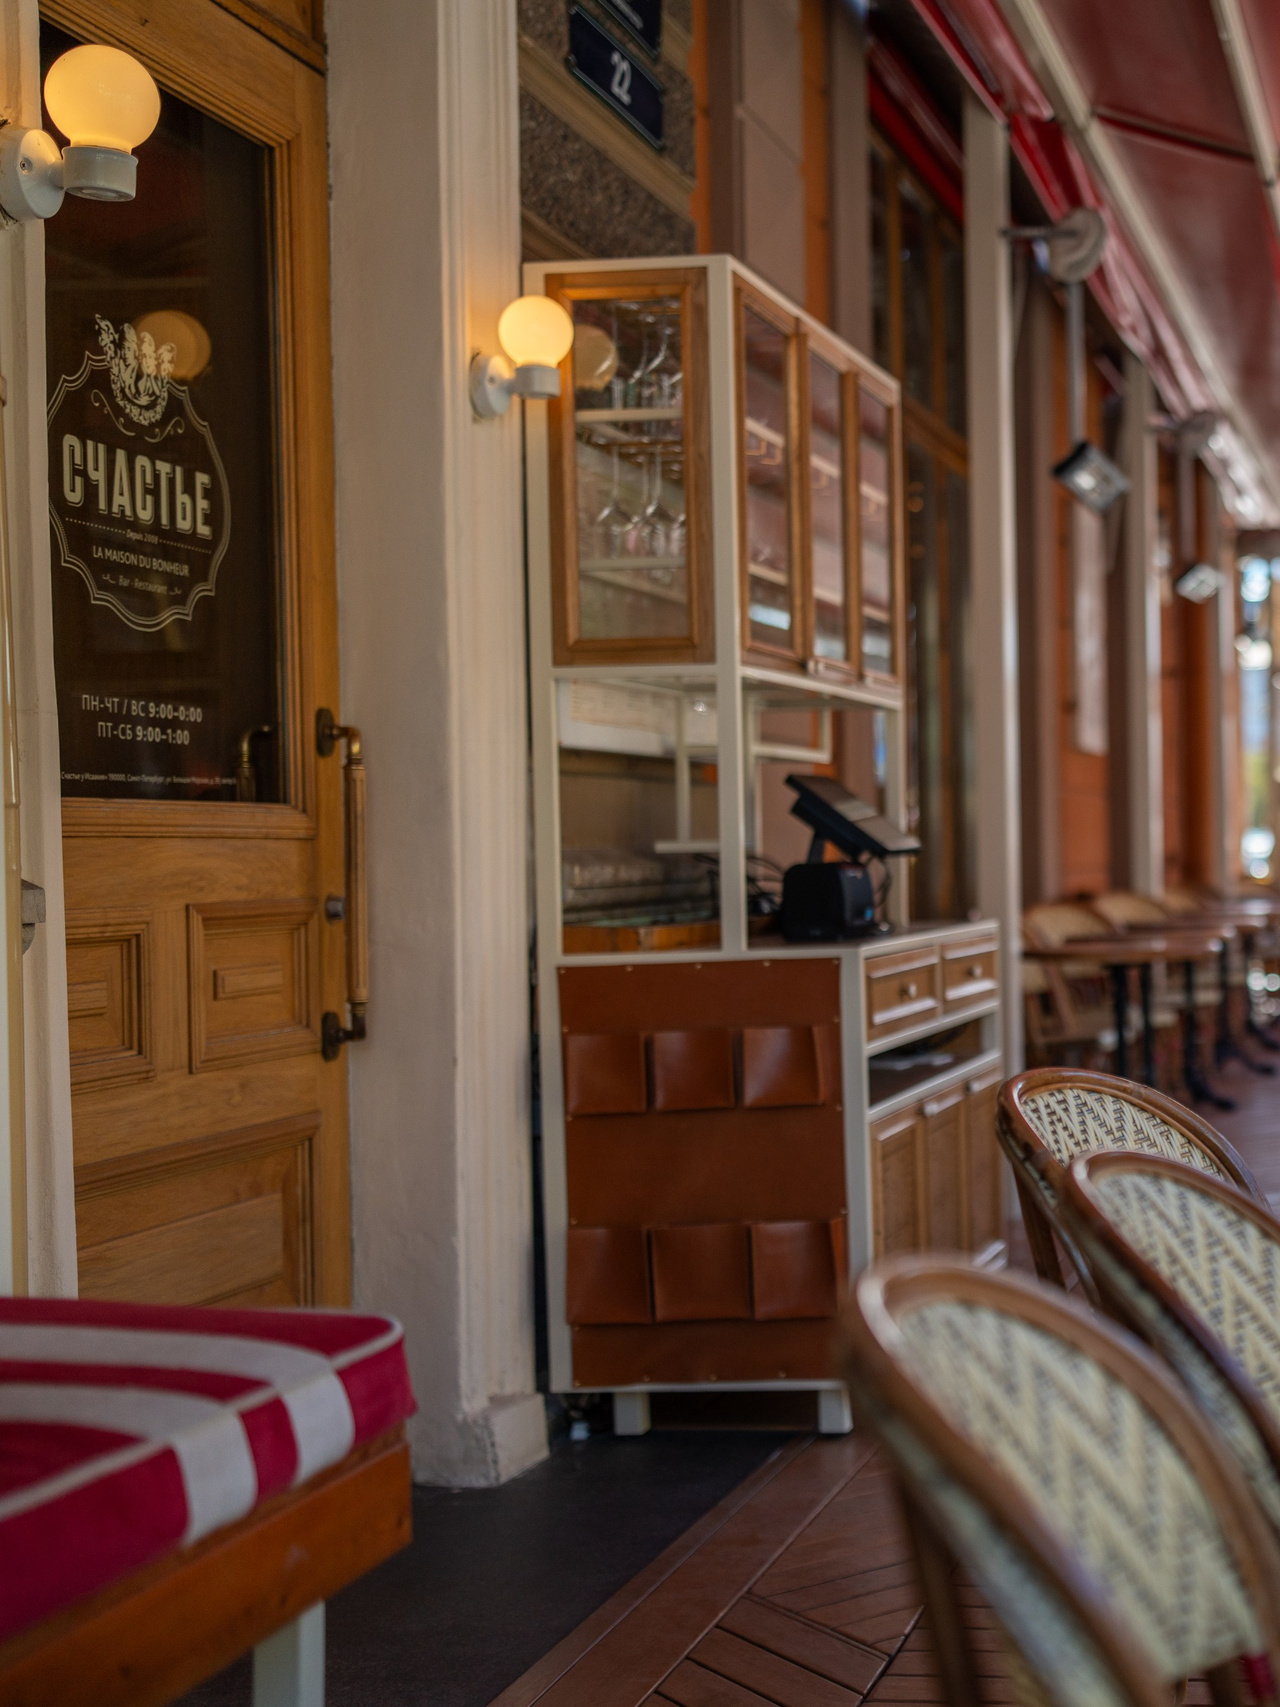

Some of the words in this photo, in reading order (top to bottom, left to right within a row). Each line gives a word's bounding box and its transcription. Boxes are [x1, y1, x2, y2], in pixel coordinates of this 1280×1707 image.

[62, 433, 212, 540] СЧАСТЬЕ
[92, 545, 104, 559] LA
[104, 548, 138, 566] MAISON
[138, 555, 151, 569] DU
[152, 558, 190, 577] BONHEUR
[118, 574, 131, 587] Bar
[81, 694, 120, 713] ПН-ЧТ
[131, 700, 146, 717] ВС
[97, 721, 133, 740] ПТ-СБ
